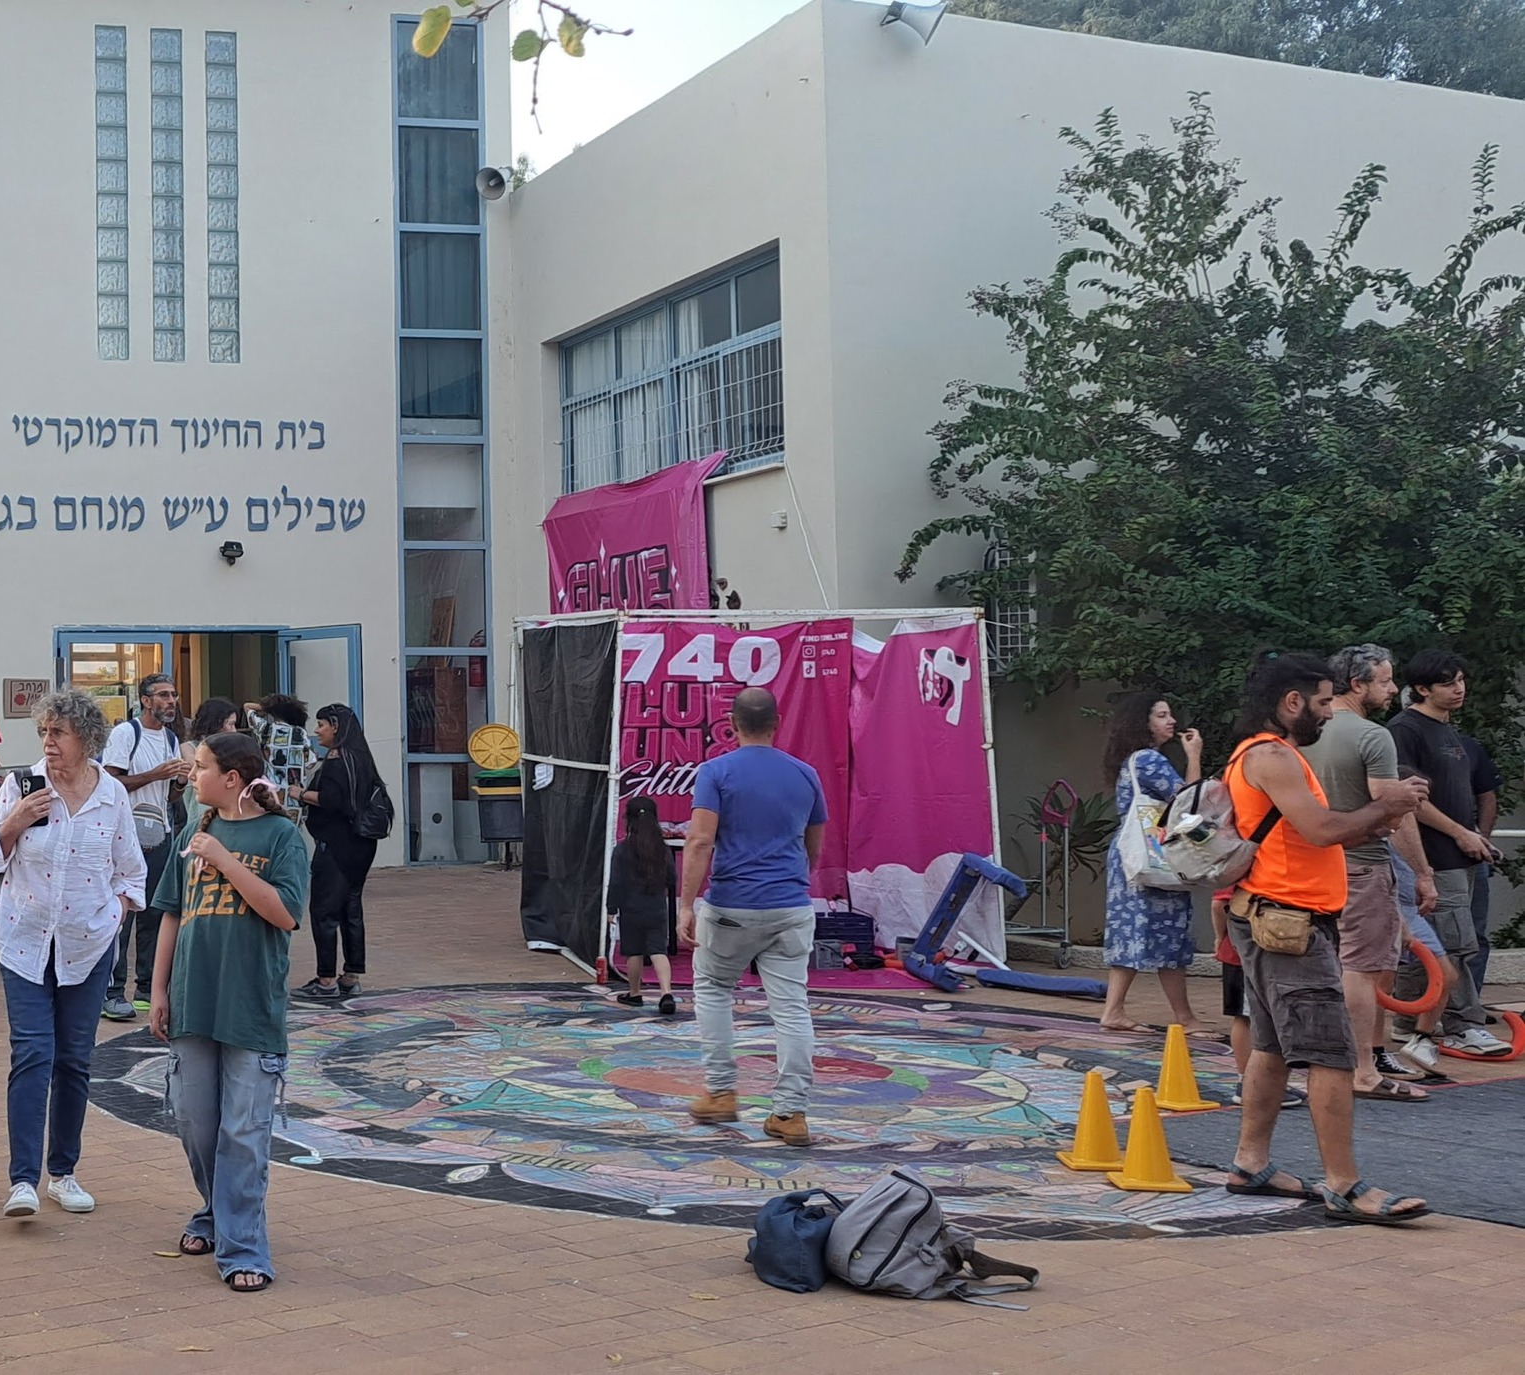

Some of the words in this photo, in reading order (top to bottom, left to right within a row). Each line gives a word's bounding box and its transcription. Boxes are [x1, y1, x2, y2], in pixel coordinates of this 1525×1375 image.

[12, 414, 159, 454] הדמוקרטי
[170, 417, 263, 454] החינוך
[274, 419, 327, 450] בית
[52, 494, 146, 532] מנחם
[245, 485, 366, 533] שבילים
[620, 681, 747, 729] LUE
[619, 759, 699, 800] Glitt
[242, 853, 270, 871] LET
